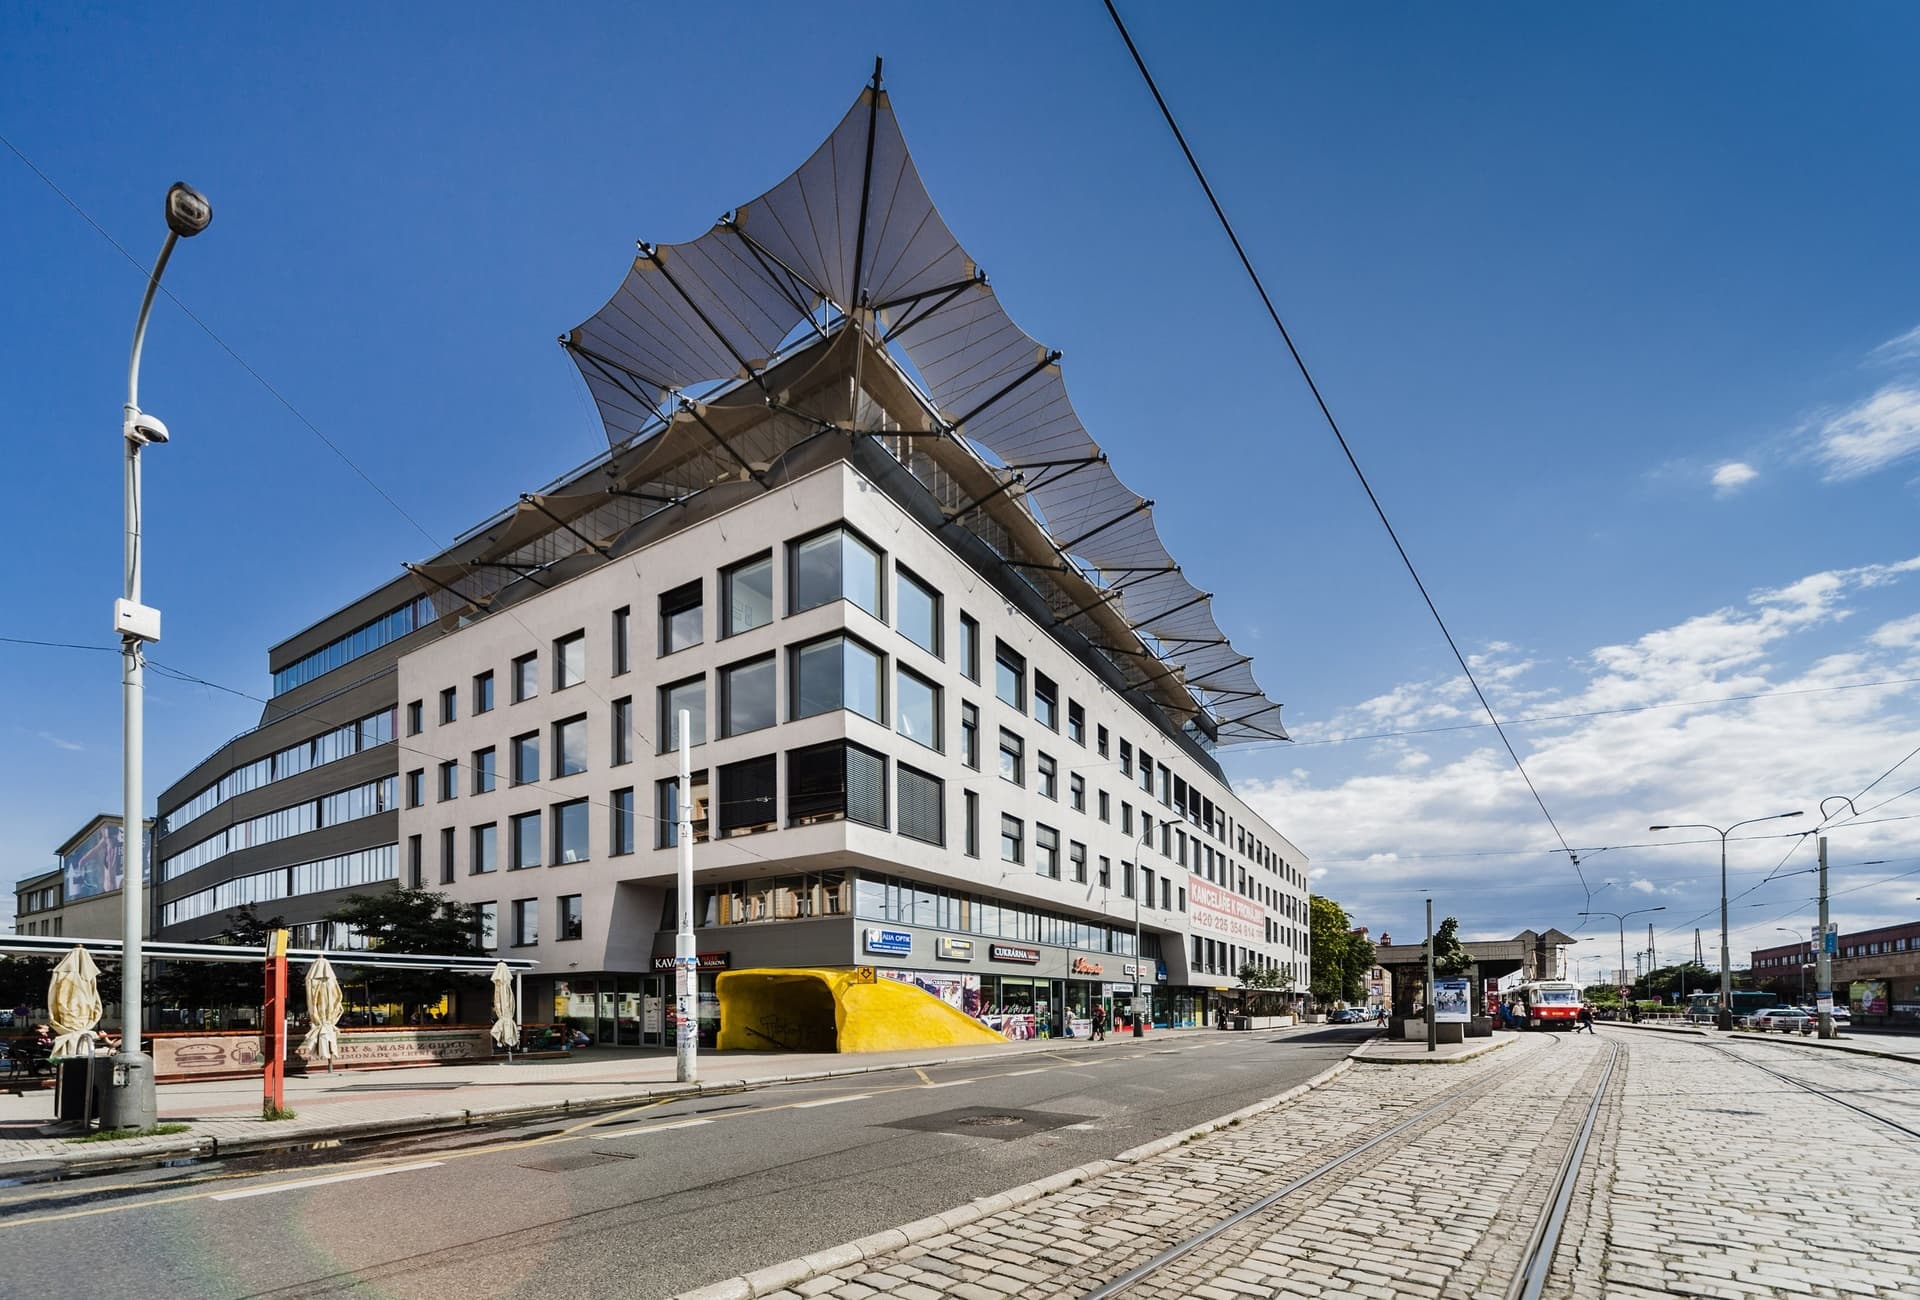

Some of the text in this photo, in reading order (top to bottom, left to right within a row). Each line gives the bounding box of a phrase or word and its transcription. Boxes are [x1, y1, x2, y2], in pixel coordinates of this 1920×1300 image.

[1192, 911, 1213, 927] +420
[1215, 916, 1229, 932] 225
[994, 947, 1027, 958] CUKRÁRNA
[376, 1043, 414, 1051] MASA
[417, 1042, 425, 1050] Z
